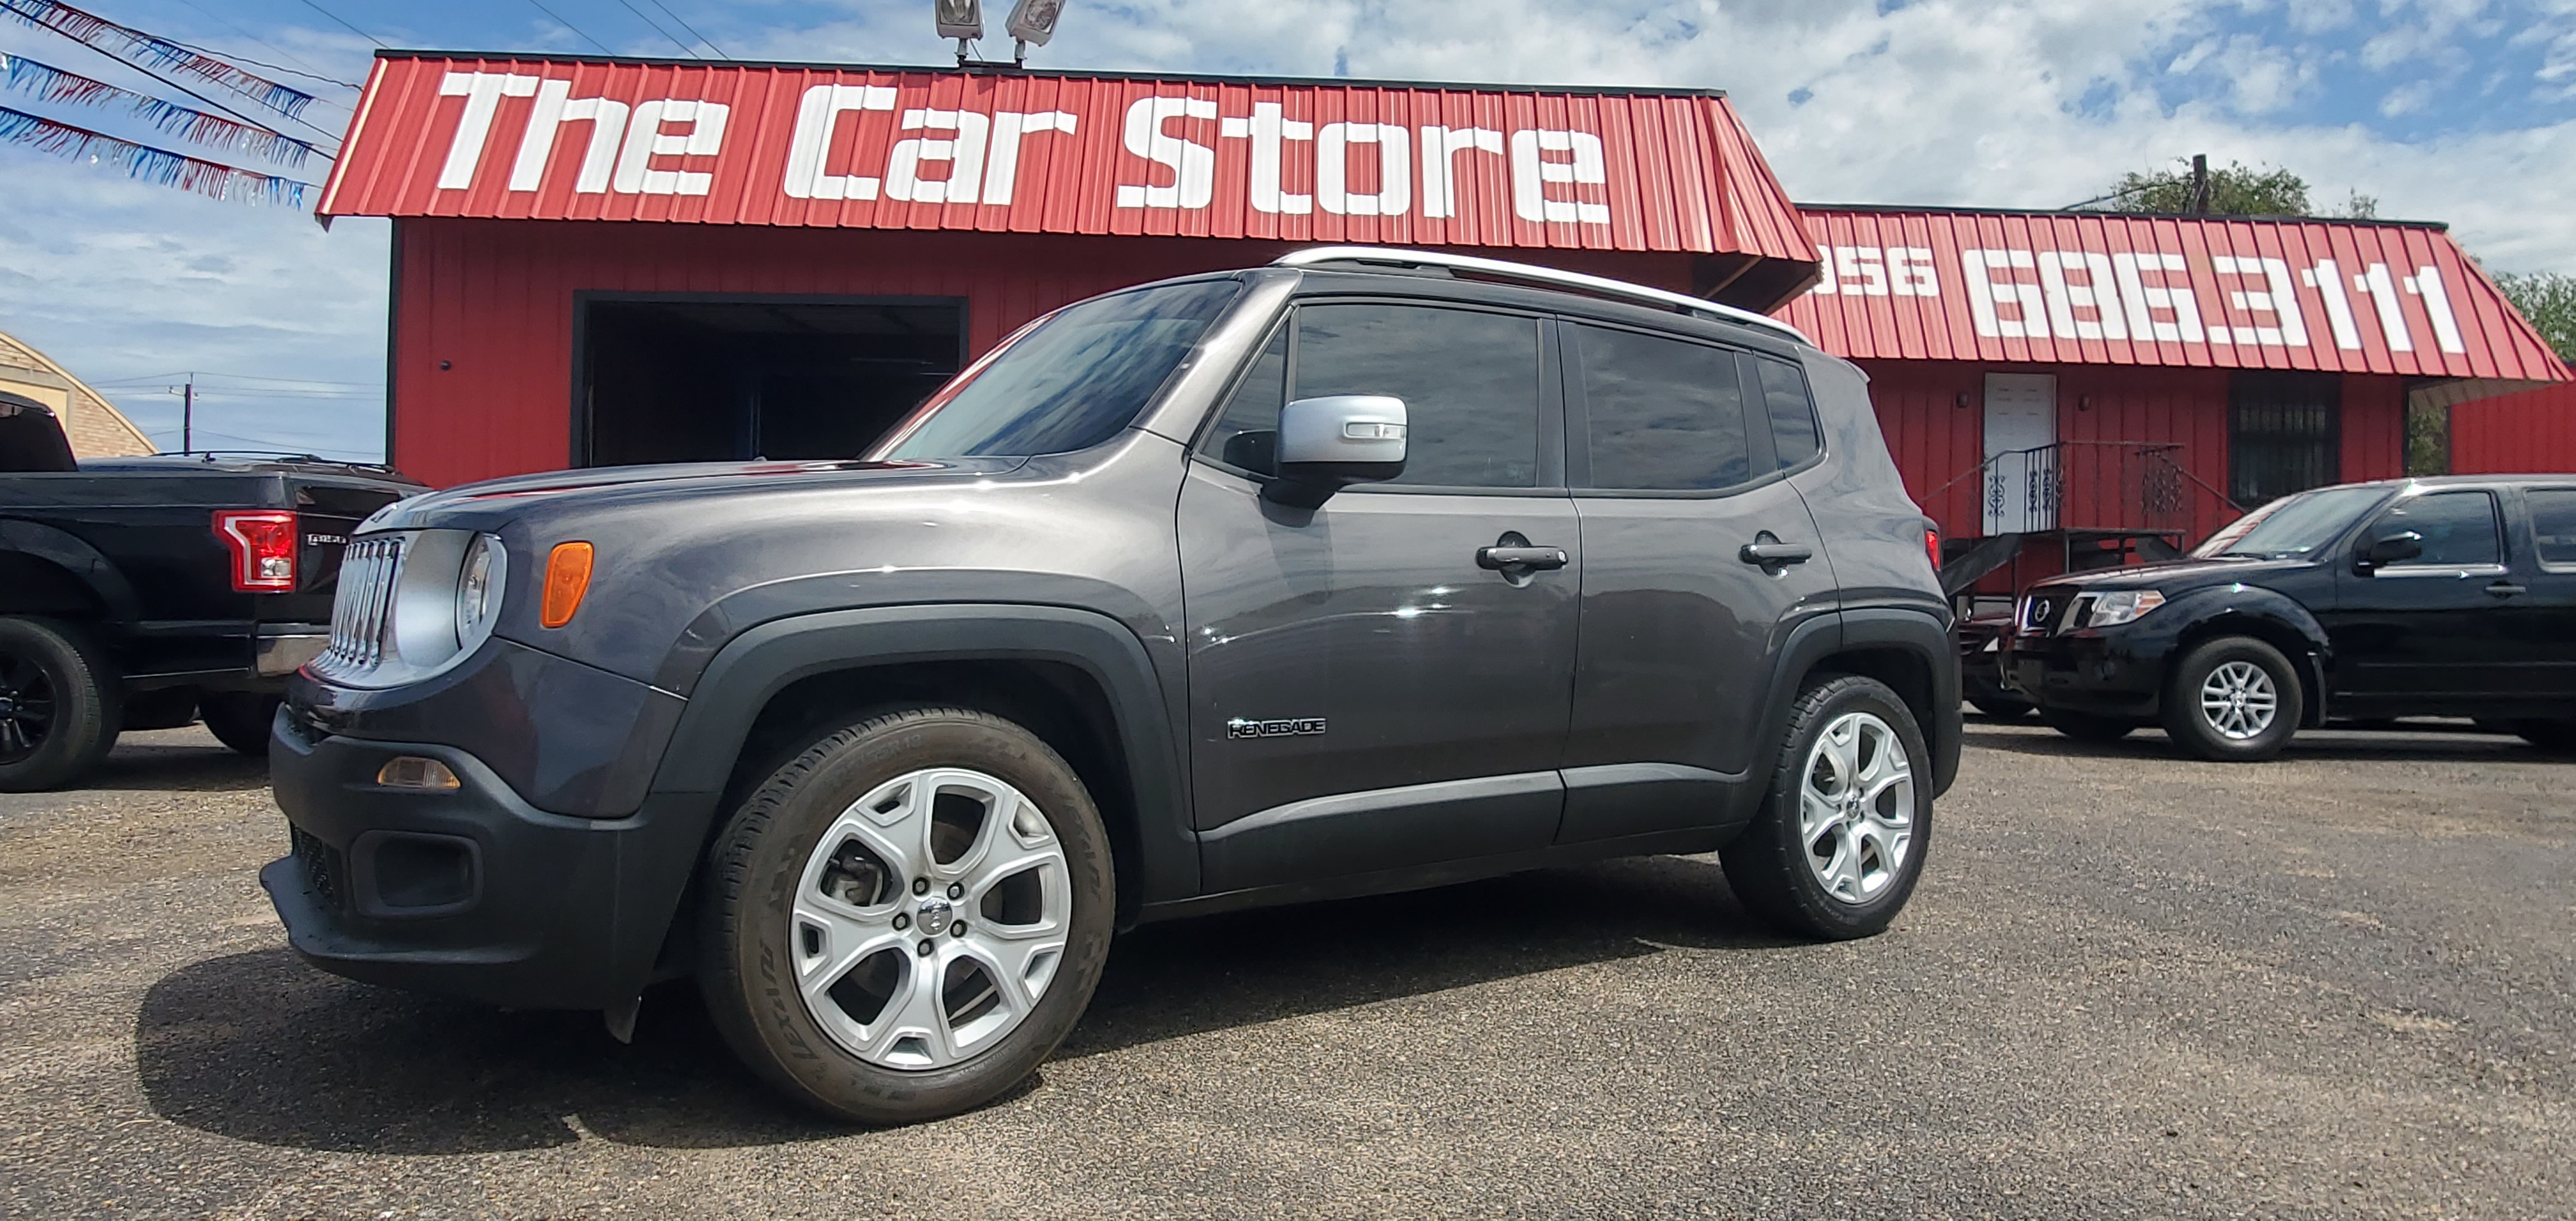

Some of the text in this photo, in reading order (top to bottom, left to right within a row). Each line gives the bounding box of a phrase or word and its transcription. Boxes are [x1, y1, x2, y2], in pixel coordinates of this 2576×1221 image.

[437, 71, 1611, 225] The Car Store
[1227, 716, 1326, 740] RENEGADE
